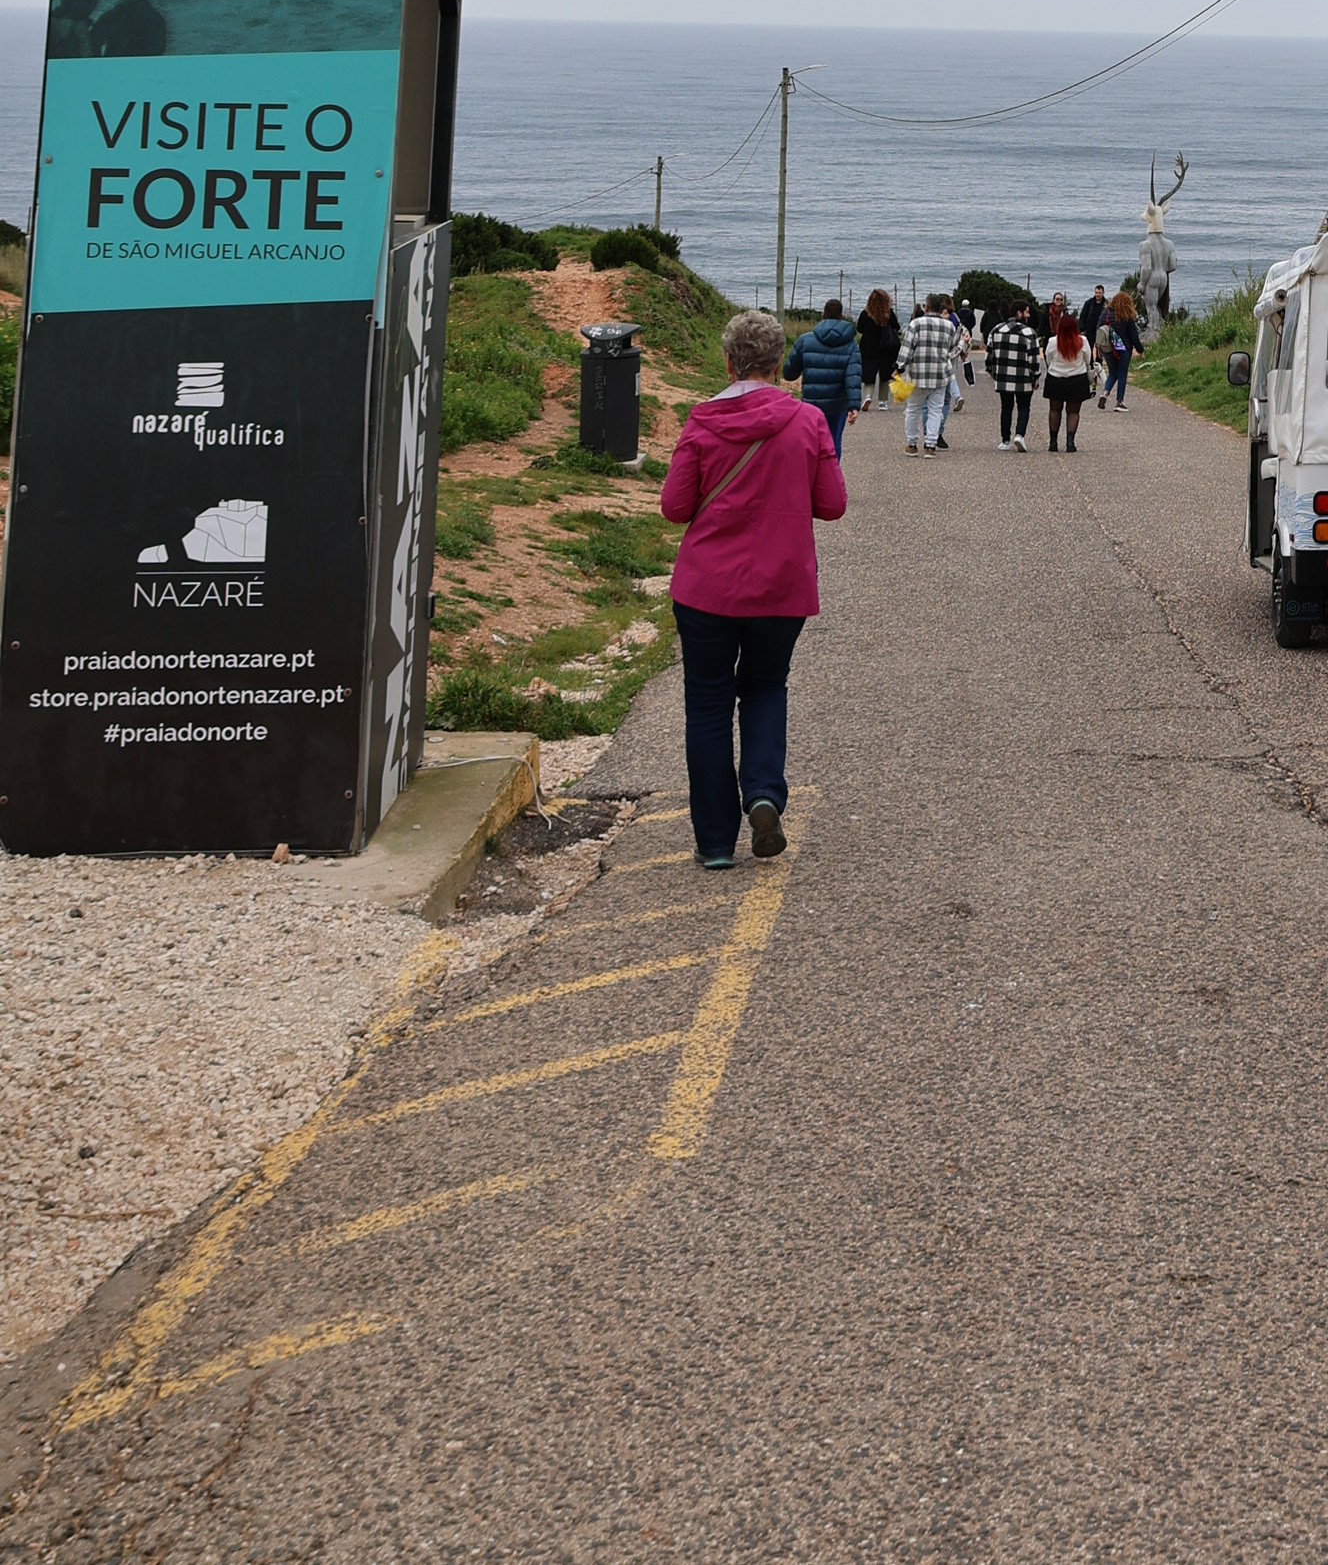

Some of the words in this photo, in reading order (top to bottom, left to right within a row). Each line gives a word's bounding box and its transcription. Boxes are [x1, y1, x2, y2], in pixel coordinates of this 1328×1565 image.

[91, 100, 289, 151] VISITE
[304, 104, 353, 153] O
[86, 167, 346, 231] FORTE
[86, 242, 114, 260] DE
[118, 239, 160, 260] SÃO
[164, 242, 244, 261] MIGUEL
[248, 243, 345, 262] ARCANJO
[424, 230, 437, 332] NA
[132, 410, 210, 434] nazaré
[194, 423, 285, 452] qualifica
[132, 576, 265, 608] NAZARÉ
[63, 649, 316, 675] praiadonortenazare.pt
[29, 684, 345, 711] store.praiadonortenazare.pt
[103, 722, 269, 747] #praiadonorte
